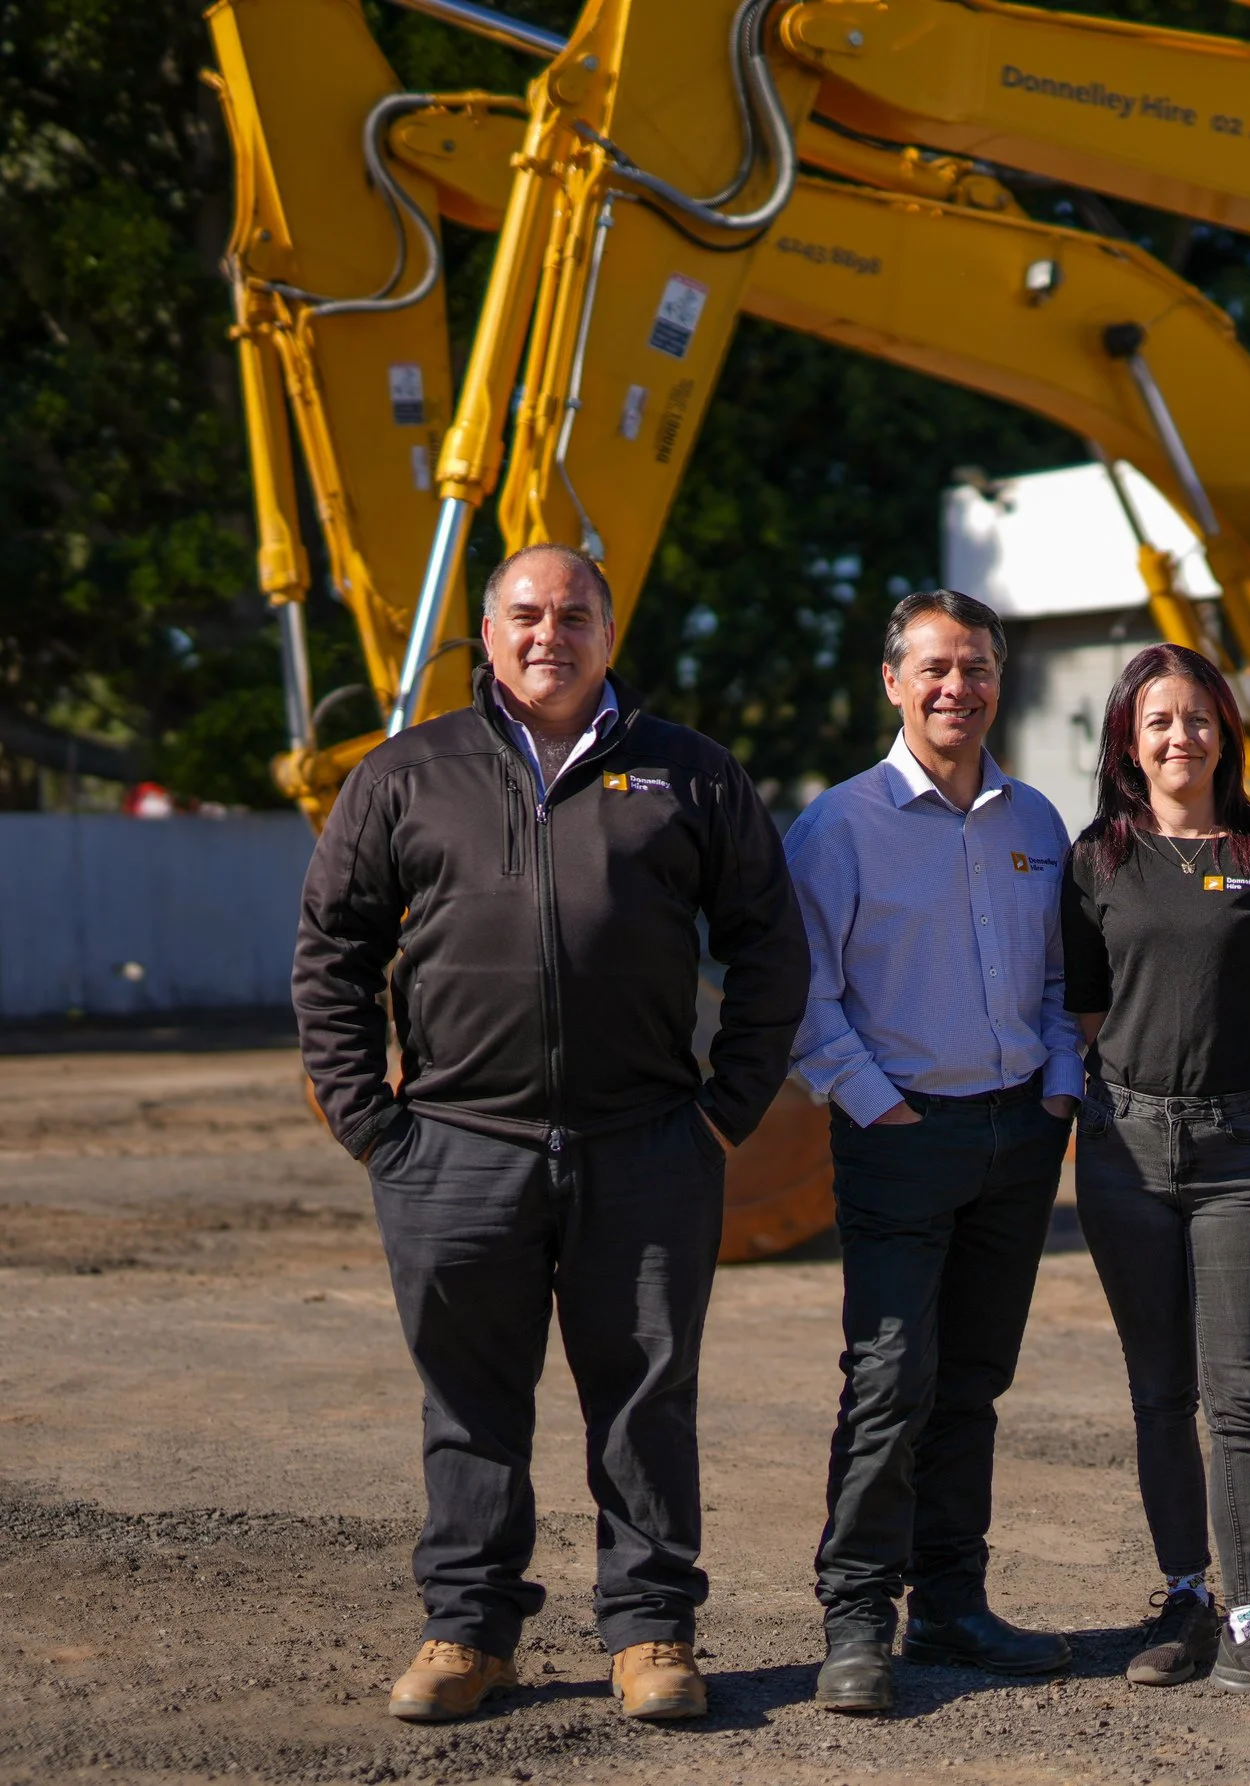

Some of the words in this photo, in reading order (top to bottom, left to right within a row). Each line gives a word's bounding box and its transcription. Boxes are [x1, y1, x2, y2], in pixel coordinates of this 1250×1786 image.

[1002, 63, 1136, 119] Donnelley
[1140, 94, 1198, 126] Hire
[1210, 114, 1243, 136] 02
[776, 235, 829, 265] 4243
[630, 775, 671, 789] Donnelley
[631, 782, 648, 791] Hire
